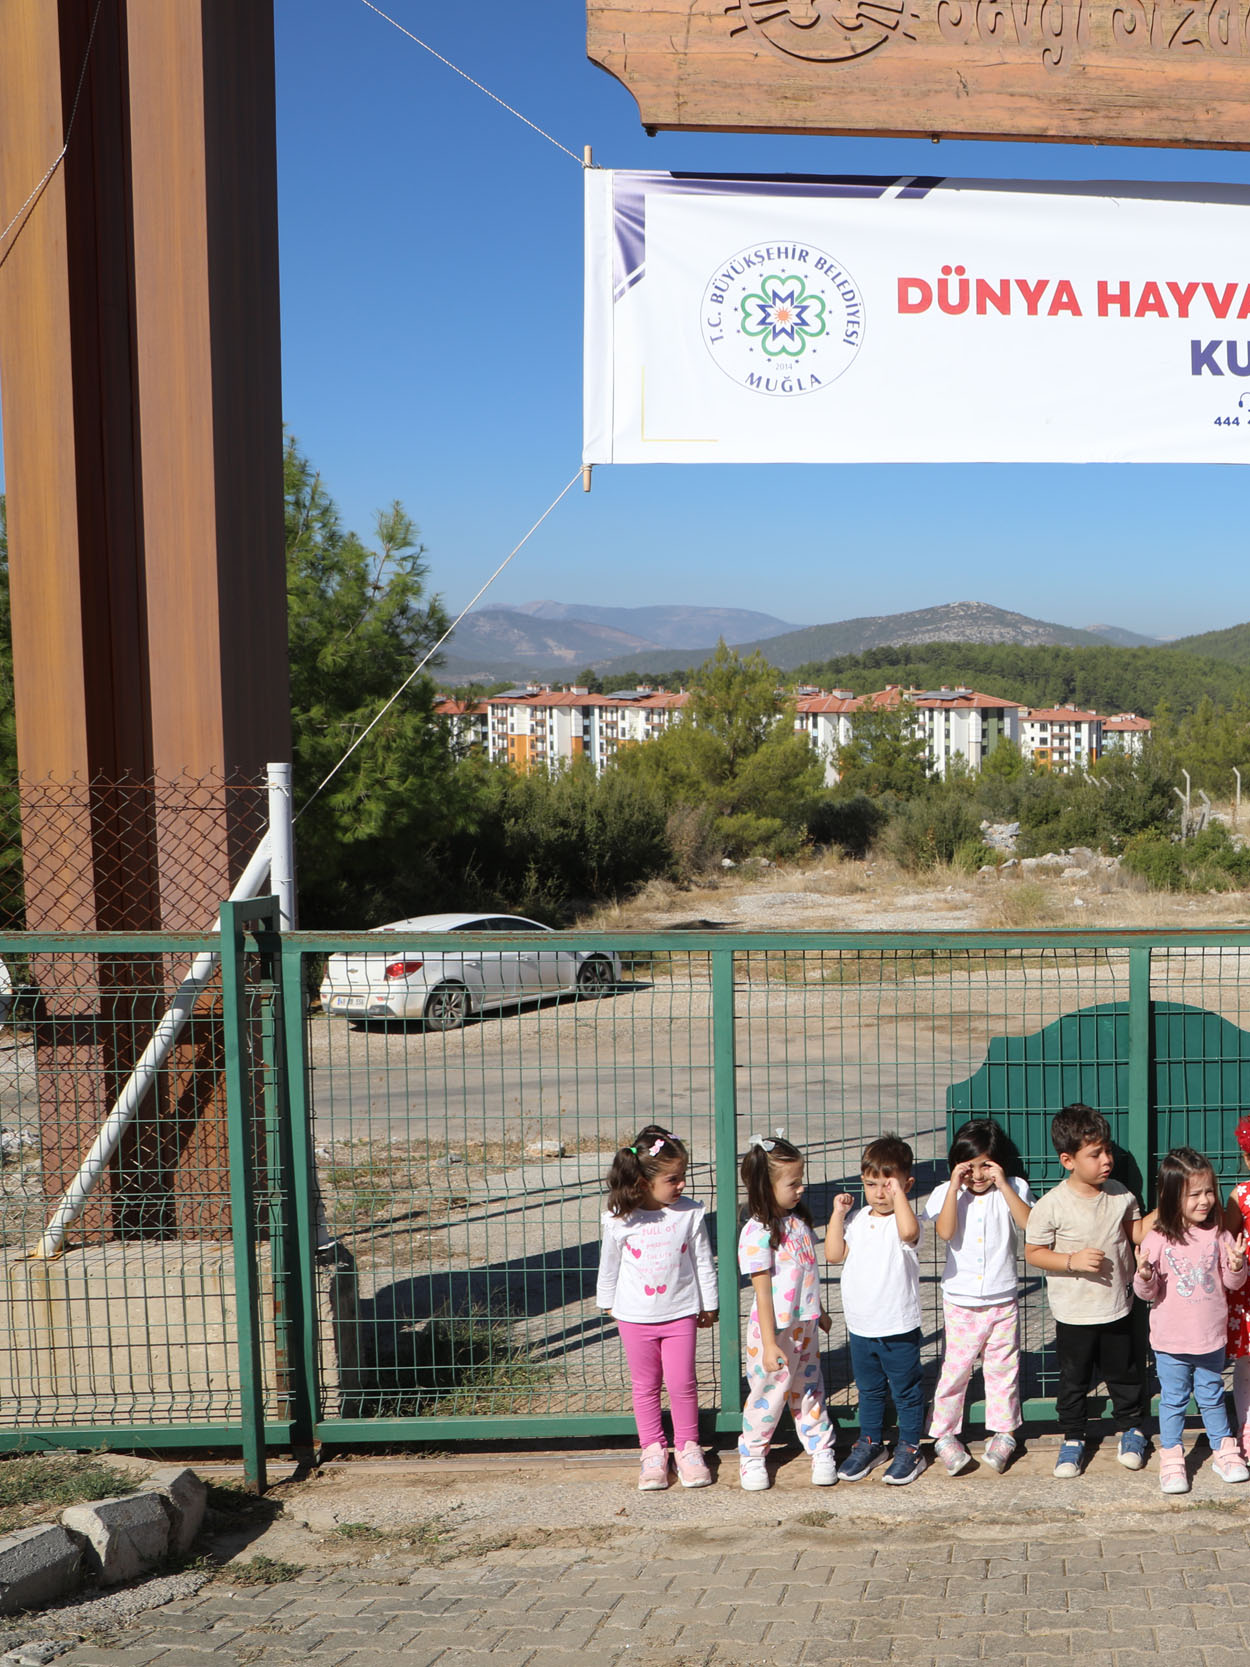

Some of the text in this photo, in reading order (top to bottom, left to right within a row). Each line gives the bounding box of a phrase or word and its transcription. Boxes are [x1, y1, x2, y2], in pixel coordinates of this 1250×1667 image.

[710, 244, 809, 304] BÜYÜKŞEHİR
[814, 256, 862, 347] BELEDİYESİ
[897, 264, 1083, 317] DÜNYA
[745, 372, 822, 393] MUĞLA
[1213, 416, 1241, 427] 444
